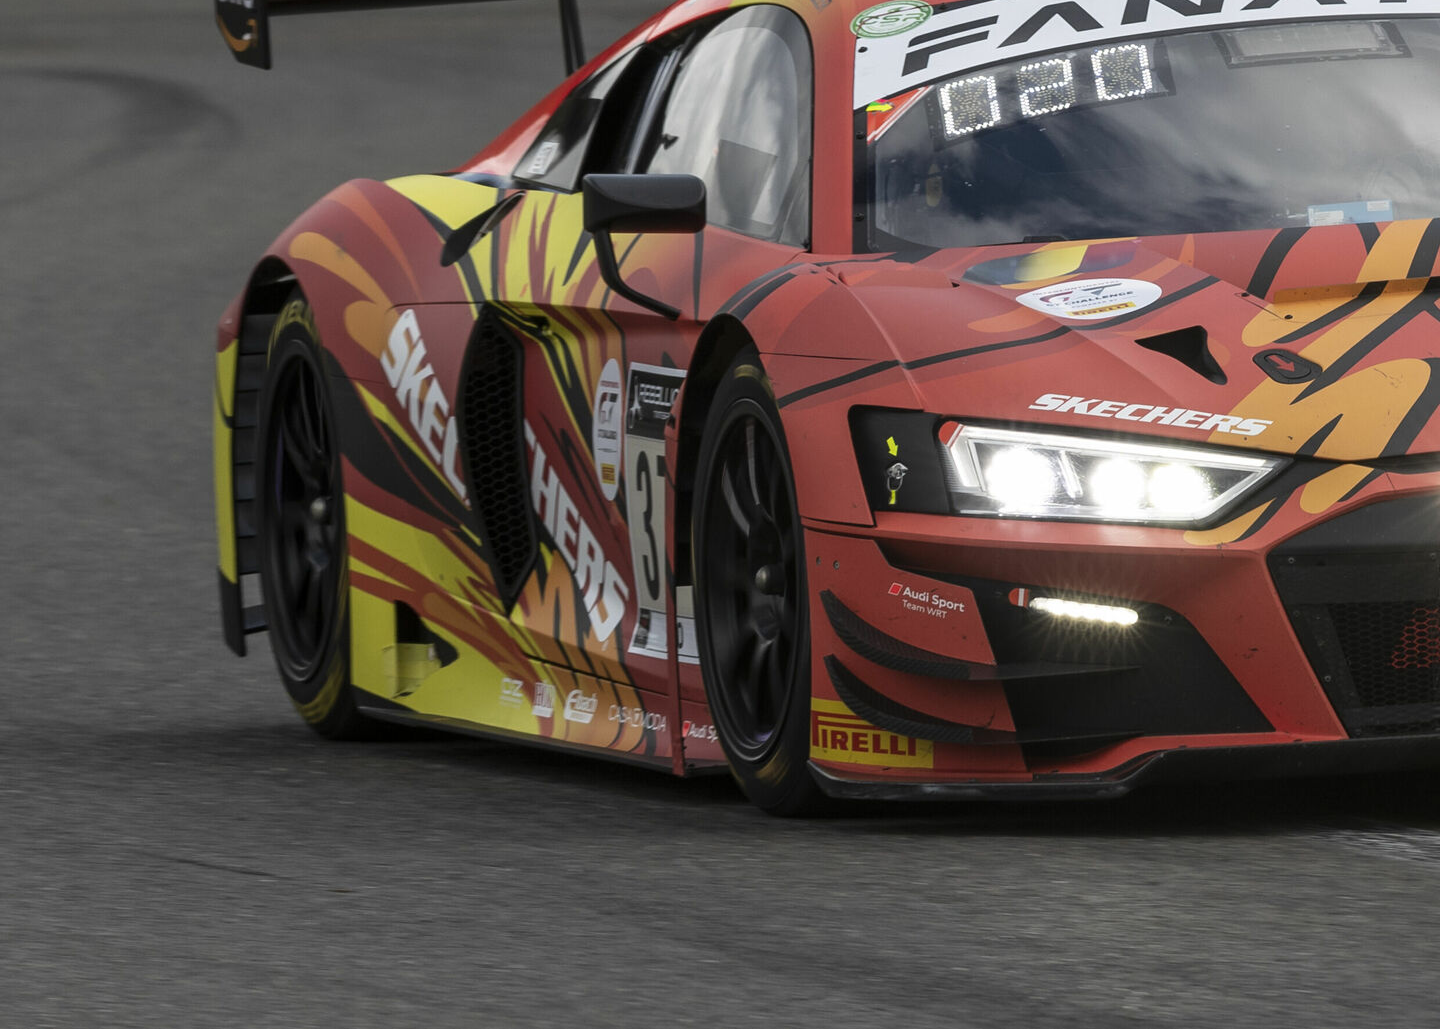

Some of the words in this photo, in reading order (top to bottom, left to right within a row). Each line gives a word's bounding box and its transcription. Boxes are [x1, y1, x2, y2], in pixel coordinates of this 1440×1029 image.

[1028, 392, 1274, 437] SKECHERS
[902, 599, 926, 612] Team
[927, 607, 947, 619] WRT
[903, 586, 929, 602] Audi
[932, 594, 965, 612] Sport
[811, 710, 917, 757] PIRELLI
